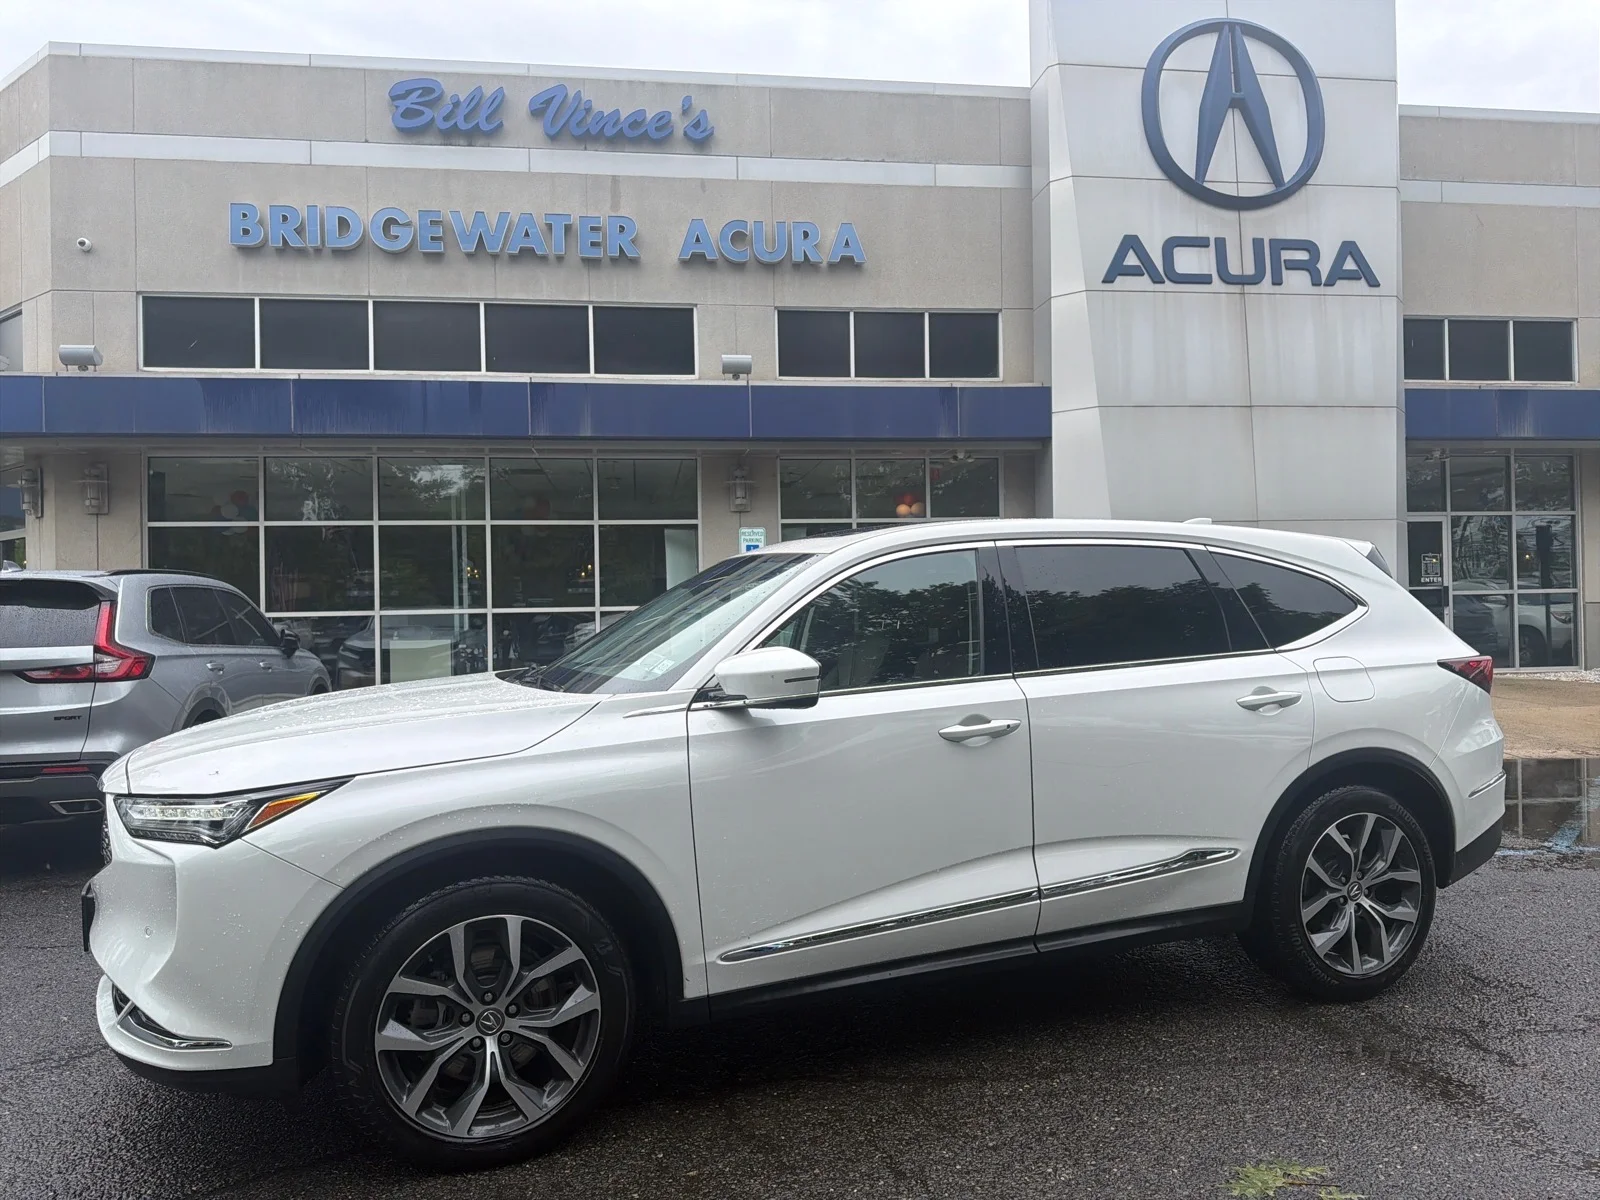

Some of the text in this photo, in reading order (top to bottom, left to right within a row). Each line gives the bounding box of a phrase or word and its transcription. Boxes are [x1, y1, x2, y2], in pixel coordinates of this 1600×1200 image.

[388, 78, 714, 143] Bill Vince's
[229, 202, 867, 264] BRIDGEWATER ACURA
[1101, 234, 1381, 287] ACURA
